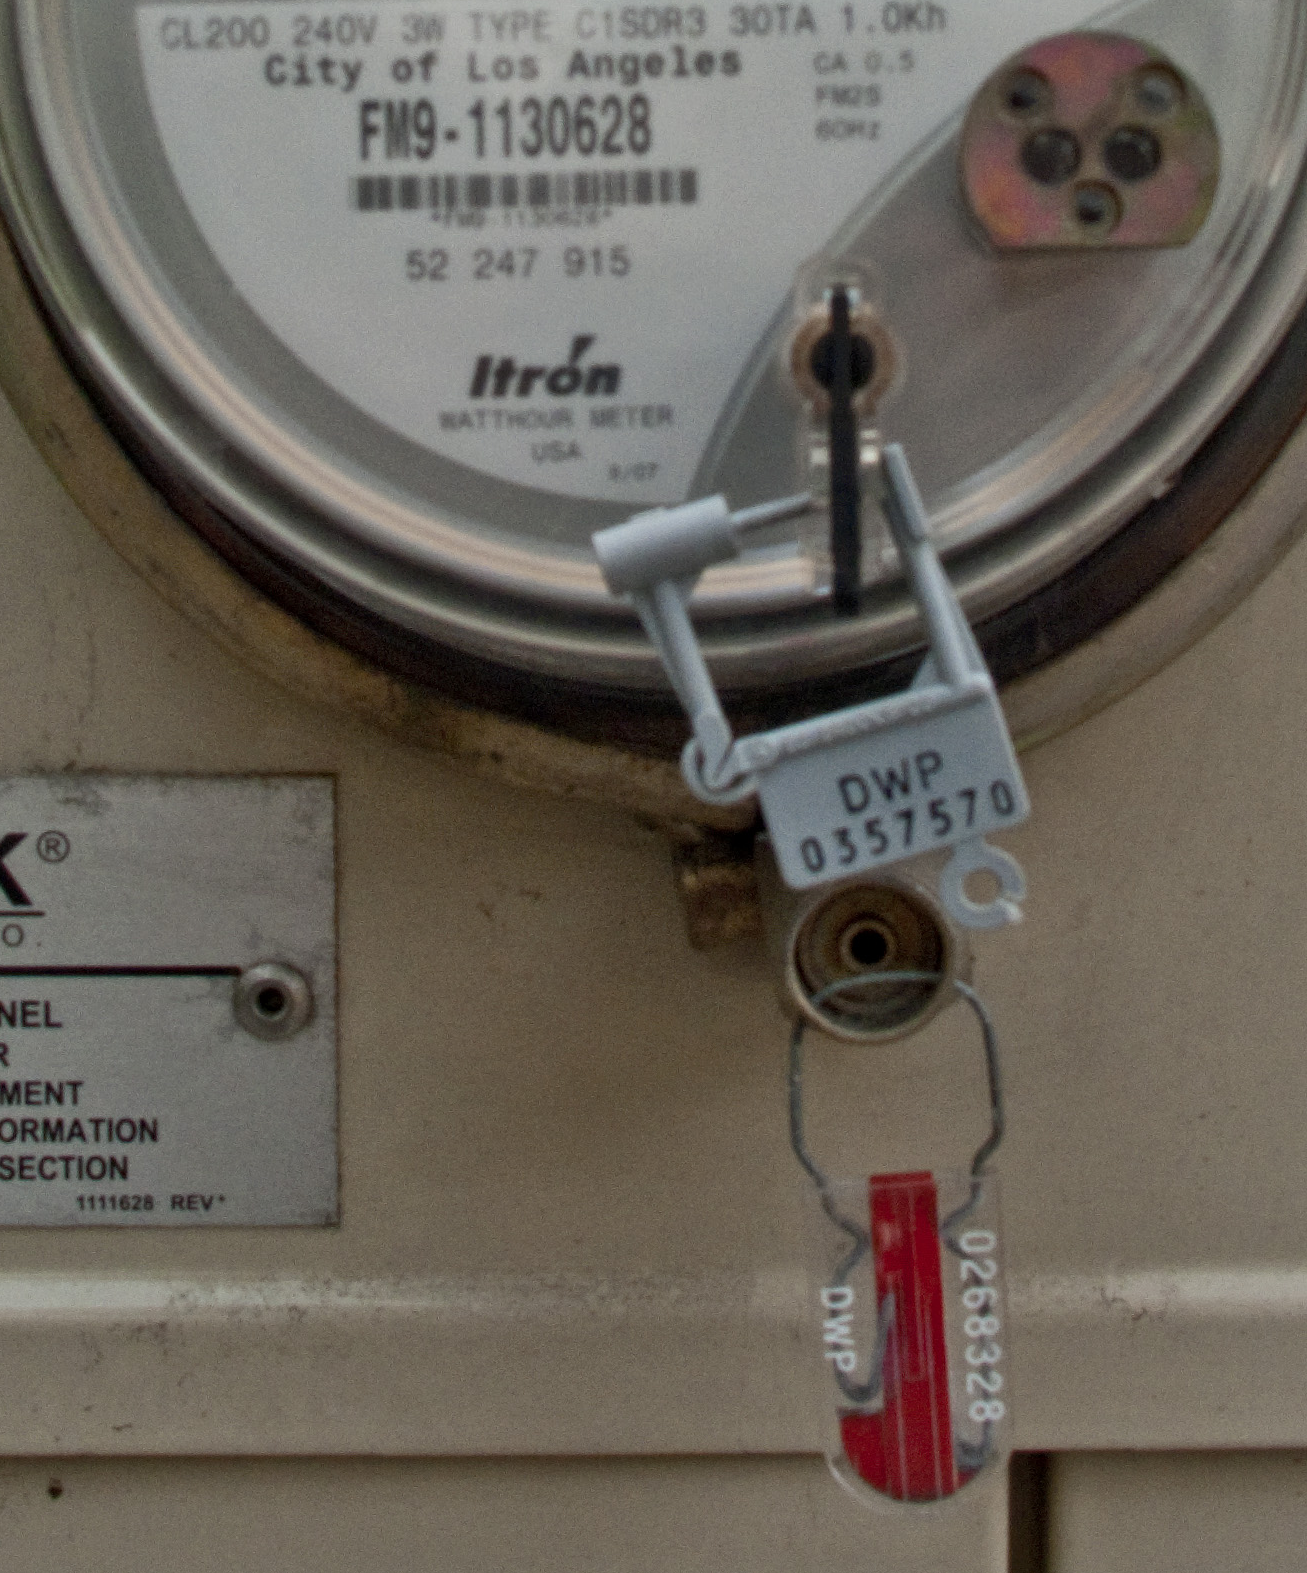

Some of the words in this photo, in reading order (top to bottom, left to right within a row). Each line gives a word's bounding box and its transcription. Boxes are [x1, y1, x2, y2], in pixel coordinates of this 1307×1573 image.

[161, 13, 271, 49] CL200
[293, 12, 378, 47] 240V
[402, 11, 445, 45] 3W
[469, 7, 553, 43] TYPE
[730, 2, 817, 36] 30TA
[264, 52, 363, 92] City
[392, 50, 439, 83] of
[467, 50, 542, 83] Los
[567, 44, 742, 87] Angeles
[813, 51, 848, 74] CA
[359, 93, 653, 161] FM9-1130628
[405, 247, 449, 282] 52
[473, 245, 540, 280] 247
[562, 243, 632, 278] 915
[588, 403, 673, 429] METER
[530, 440, 582, 464] USA
[838, 748, 945, 815] DWP
[800, 779, 1016, 874] 0357570
[76, 1194, 155, 1212] 1111628
[820, 1285, 858, 1373] DWP
[959, 1230, 1006, 1423] 0268328
